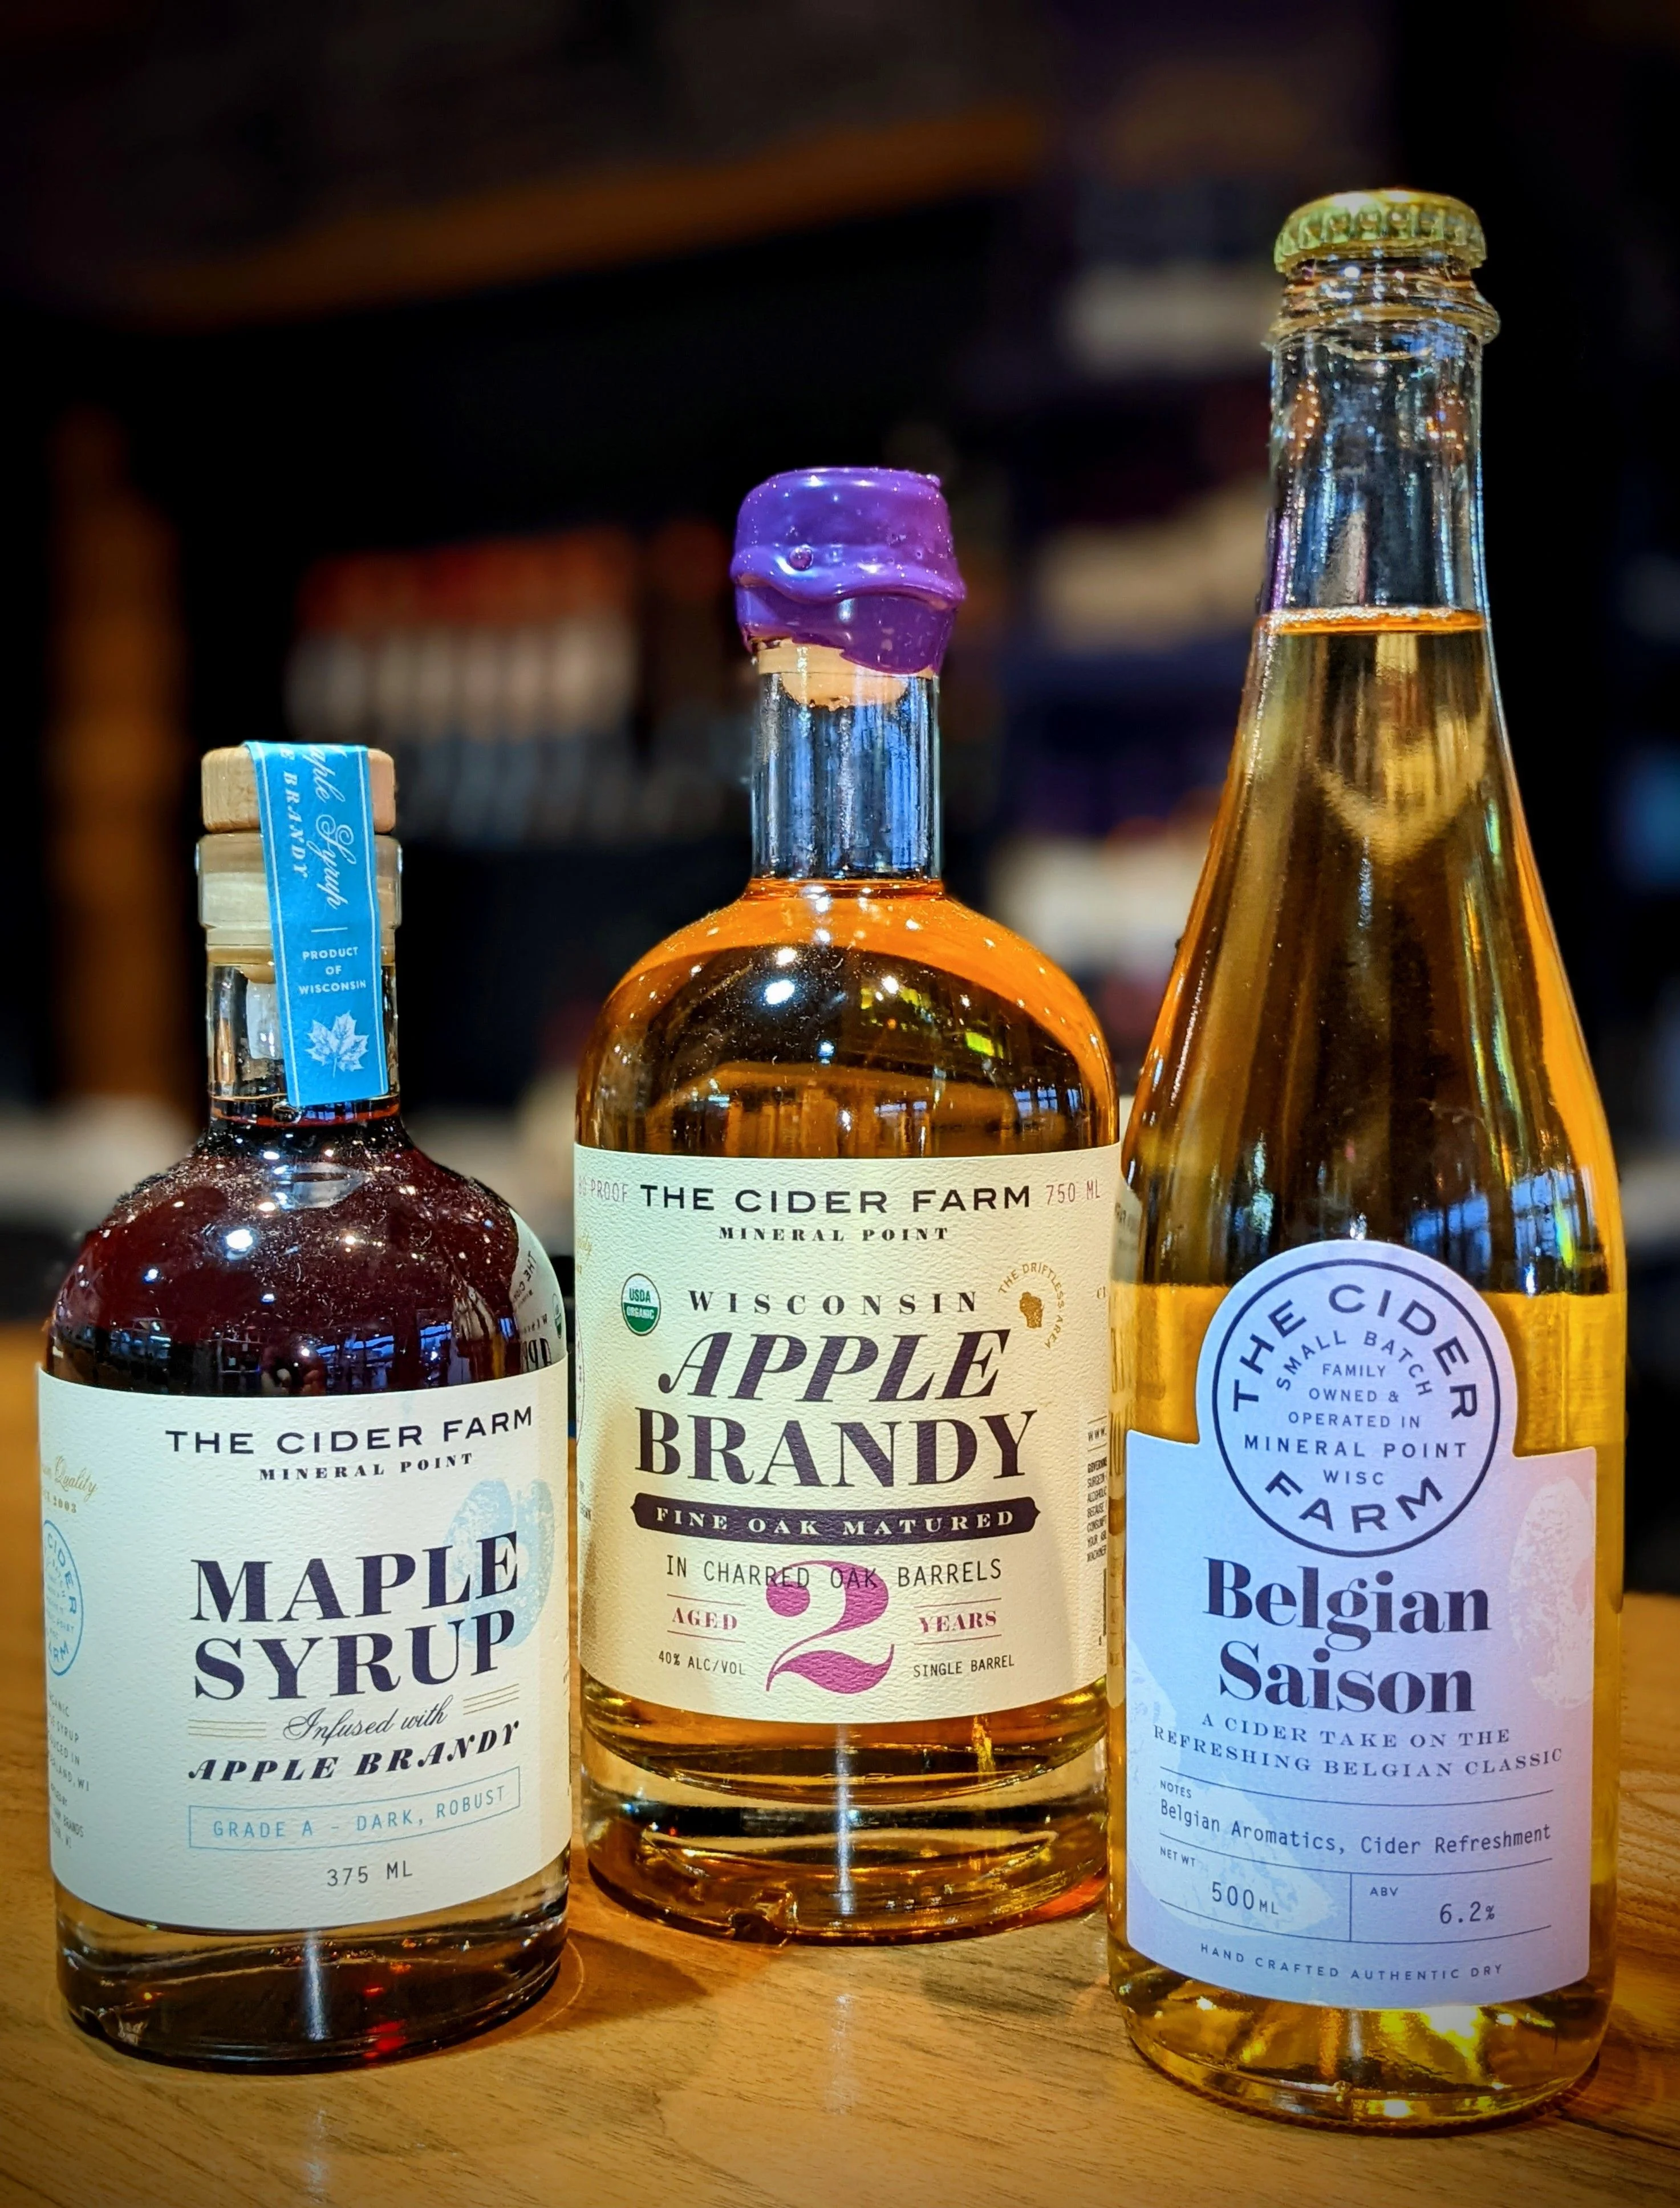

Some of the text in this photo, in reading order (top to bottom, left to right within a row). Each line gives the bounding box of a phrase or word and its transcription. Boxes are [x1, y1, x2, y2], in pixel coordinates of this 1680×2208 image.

[283, 771, 308, 878] BRANDY
[306, 814, 356, 910] Syrup
[302, 946, 359, 961] PRODUCT
[326, 966, 342, 975] OF
[299, 980, 367, 995] WISCONSIN
[591, 1179, 629, 1203] PROOF
[640, 1184, 1030, 1214] THE CIDER FARM
[1045, 1179, 1101, 1205] 750 ML
[719, 1226, 948, 1242] MINERAL POINT
[629, 1287, 651, 1303] USDA
[688, 1291, 976, 1315] WISCONSIN
[998, 1262, 1064, 1348] THE DRIFTLESS AREA
[627, 1306, 655, 1320] ORGANIC
[658, 1329, 1011, 1402] APPLE
[1276, 1330, 1433, 1397] SMALL BATCH
[1322, 1363, 1386, 1378] FAMILY
[1233, 1284, 1478, 1534] THE CIDER FARM
[1309, 1388, 1399, 1403] OWNED &
[165, 1405, 533, 1455] THE CIDER FARM
[1288, 1412, 1420, 1428] OPERATED IN
[635, 1407, 1037, 1487] BRANDY
[1244, 1435, 1466, 1458] MINERAL POINT
[55, 1456, 98, 1502] Quality
[259, 1452, 474, 1481] MINERAL POINT
[1324, 1469, 1384, 1485] WISC
[656, 1507, 1013, 1536] FINE OAK MATURED
[190, 1530, 518, 1623] MAPLE
[667, 1554, 1001, 1589] IN CHARRED OAK BARRELS
[1203, 1557, 1491, 1652] Belgian
[672, 1560, 996, 1694] AGED 2 YEARS
[195, 1609, 515, 1700] SYRUP
[659, 1650, 745, 1675] 40% ALC/VOL
[914, 1654, 1015, 1678] SINGLE BARREL
[1219, 1640, 1476, 1713] Saison
[283, 1695, 454, 1746] Infused with
[1202, 1713, 1511, 1748] A CIDER TAKE ON THE
[188, 1720, 520, 1782] APPLE BRANDY
[1153, 1725, 1563, 1777] REFRESHING BELGIAN CLASSIC
[1160, 1780, 1192, 1798] NOTES
[213, 1820, 285, 1838] GRADE
[302, 1820, 313, 1836] A
[357, 1809, 423, 1832] DARK,
[436, 1785, 505, 1818] ROBUST
[1160, 1798, 1551, 1855] Belgian Aromatics, Cider Refreshment
[1160, 1846, 1195, 1867] NET WT
[327, 1861, 412, 1886] 375 ML
[1370, 1887, 1399, 1897] ABV
[1439, 1902, 1495, 1924] 6.2%
[1201, 1943, 1502, 1980] HAND CRAFTED AUTHENTIC DRY
